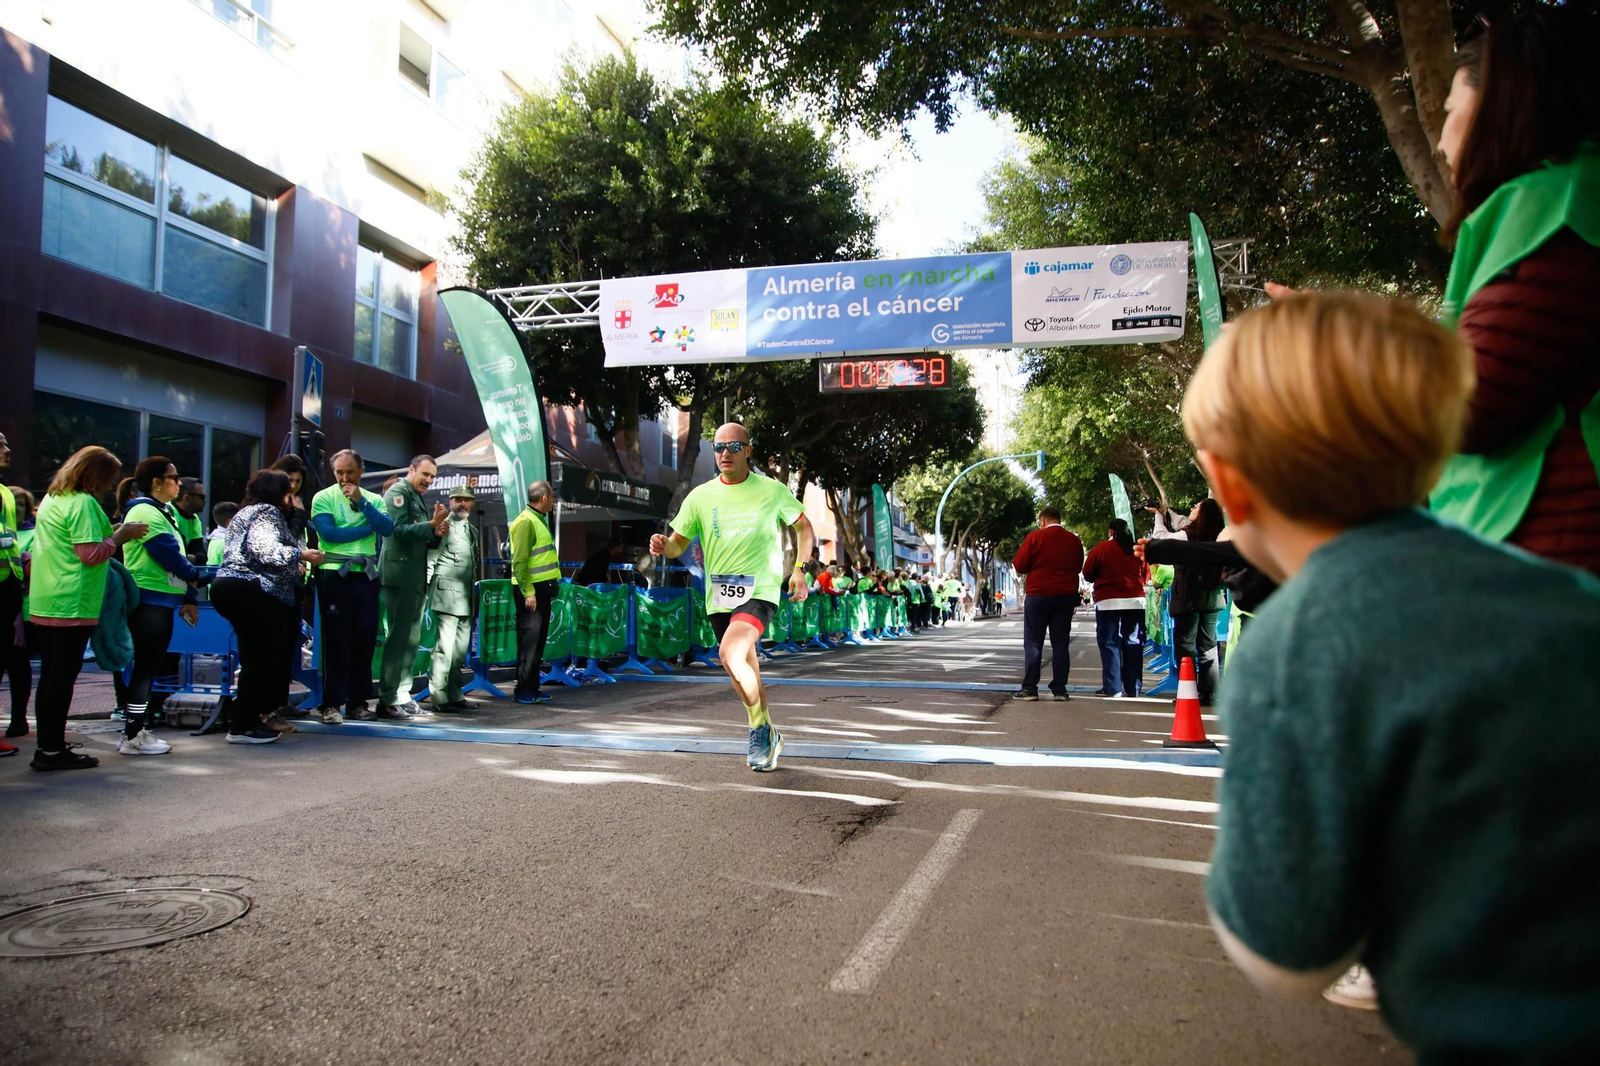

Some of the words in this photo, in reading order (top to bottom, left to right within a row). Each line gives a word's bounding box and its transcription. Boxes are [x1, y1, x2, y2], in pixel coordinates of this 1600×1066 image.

[1132, 256, 1177, 265] UNIVERSIDAD
[1043, 261, 1094, 274] cajamar
[763, 272, 855, 296] Almería
[864, 273, 892, 288] en
[901, 263, 996, 287] marcha
[1093, 288, 1152, 300] Fundación
[763, 301, 840, 323] contra
[847, 297, 870, 317] el
[877, 295, 963, 316] cáncer
[1123, 305, 1143, 316] Ejido
[1145, 304, 1172, 312] Motor
[1049, 316, 1074, 324] Toyota
[1049, 323, 1077, 332] Alborán
[1080, 322, 1101, 330] Motor
[606, 332, 638, 342] ALMERÍA
[757, 338, 835, 348] #TodosContraElCáncer
[720, 584, 746, 599] 359
